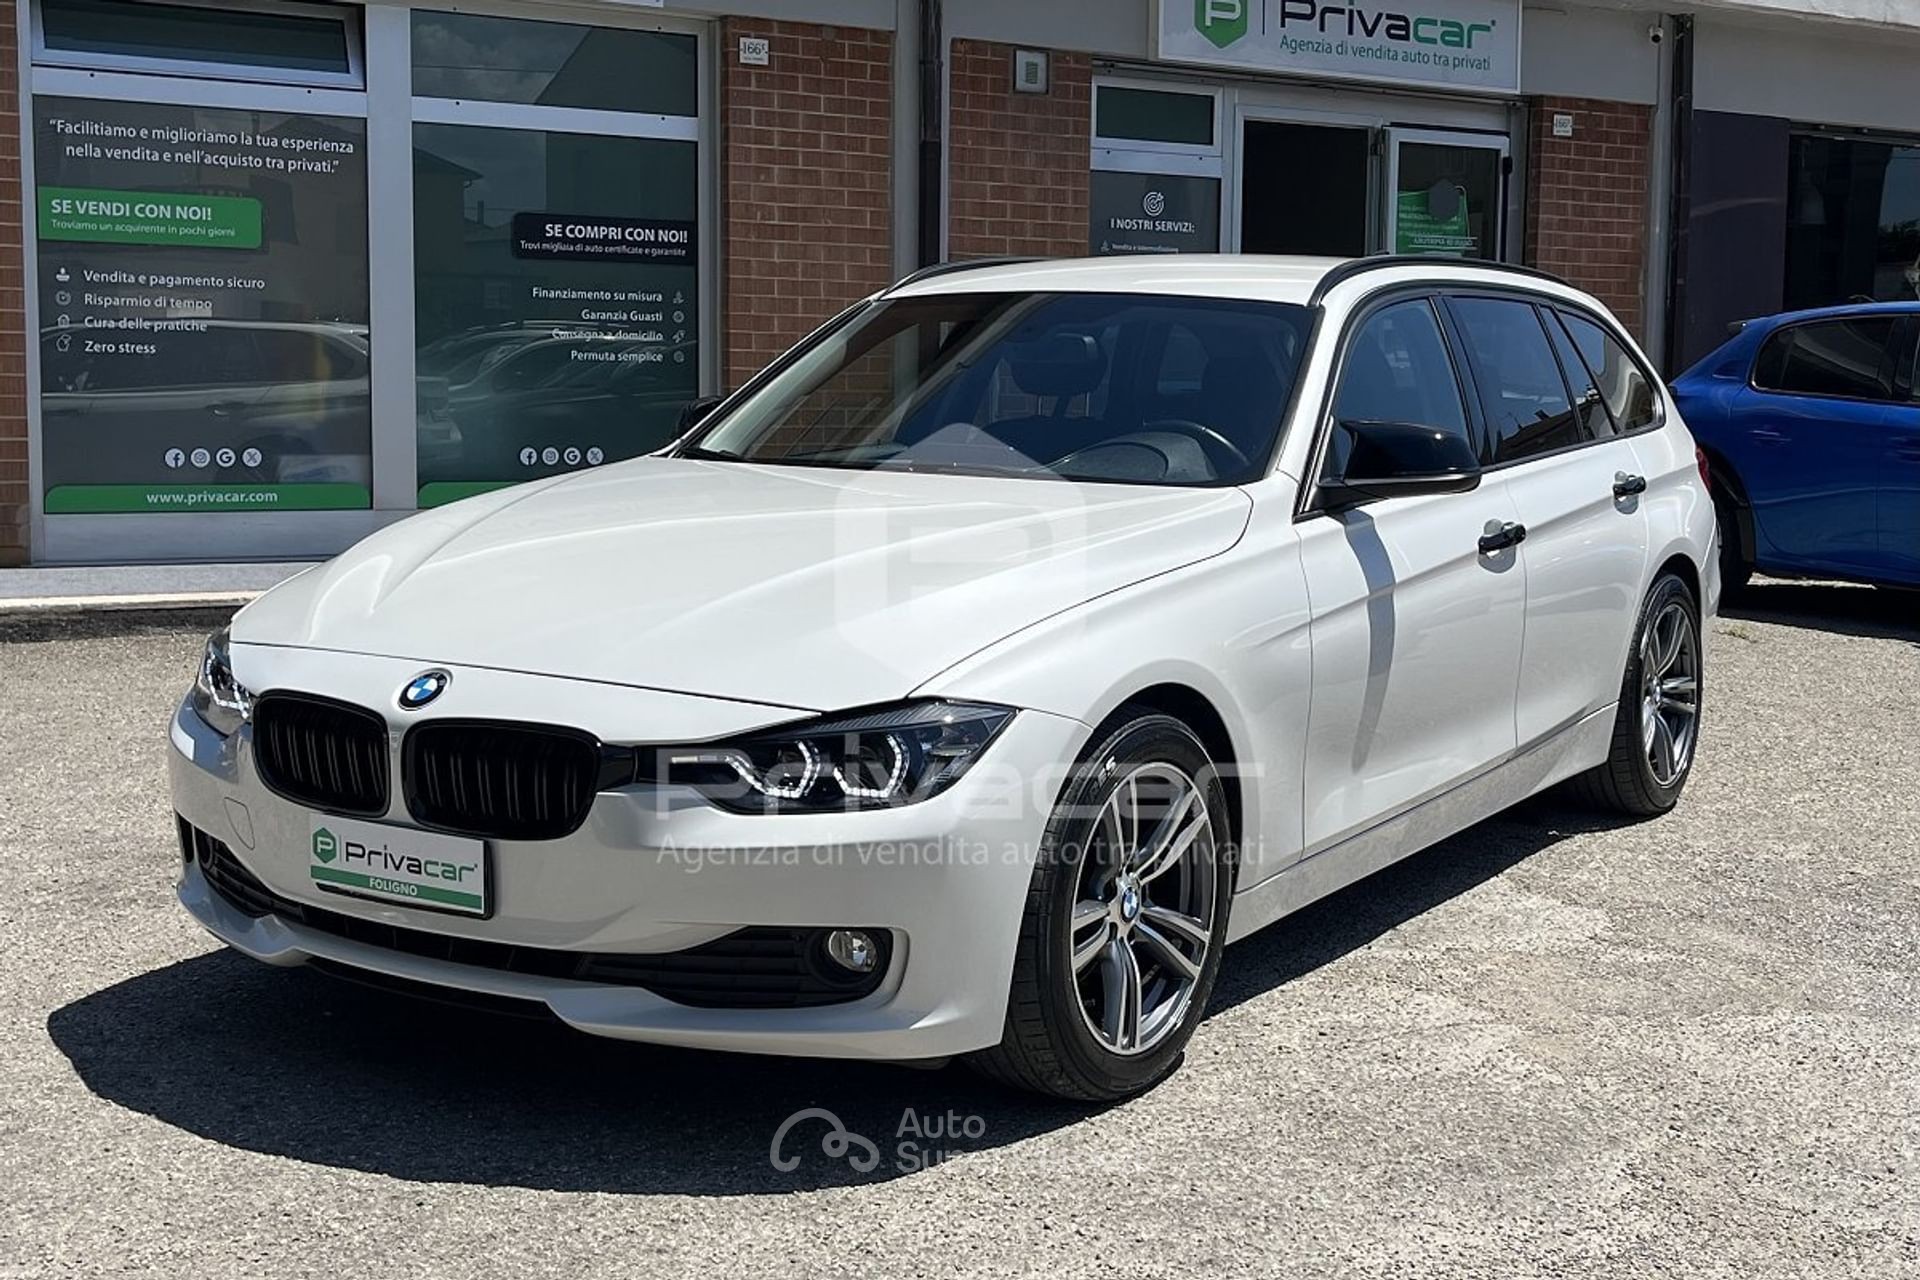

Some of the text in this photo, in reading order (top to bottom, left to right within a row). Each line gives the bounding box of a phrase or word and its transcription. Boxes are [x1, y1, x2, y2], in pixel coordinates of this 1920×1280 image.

[1280, 0, 1493, 49] Privacar
[1280, 34, 1491, 72] Agenzia di vendita auto tra privati
[139, 128, 149, 139] e
[152, 126, 238, 144] miglioriamo
[241, 131, 252, 145] la
[256, 135, 279, 147] tua
[281, 138, 354, 153] esperienza
[65, 143, 101, 158] nella
[105, 147, 160, 161] vendita
[163, 151, 172, 162] e
[266, 157, 285, 169] tra
[51, 199, 212, 221] SE VENDI CON NOI!
[51, 219, 235, 238] Troviamo un acquirente in pochi giorni
[545, 223, 689, 244] SE COMPRI CON NOI!
[1116, 218, 1153, 231] NOSTRI
[1155, 220, 1196, 233] SERVIZI:
[520, 239, 541, 250] Trovi
[542, 240, 574, 252] migliaia
[575, 243, 584, 252] di
[584, 244, 604, 253] auto
[605, 245, 643, 256] certificate
[645, 248, 650, 256] e
[84, 270, 266, 289] Vendita e pagamento sicuro
[84, 293, 213, 310] Risparmio di tempo
[532, 287, 663, 303] Finanziamento su misura
[581, 308, 663, 322] Garanzia Guasti
[84, 316, 208, 333] Cura delle pratiche
[552, 328, 664, 342] Consegna a domicilio
[84, 340, 157, 354] Zero stress
[571, 349, 664, 364] Permuta semplice
[147, 489, 278, 505] www.privacar.com
[345, 841, 477, 882] Privacar
[369, 877, 418, 896] FOLIGNO
